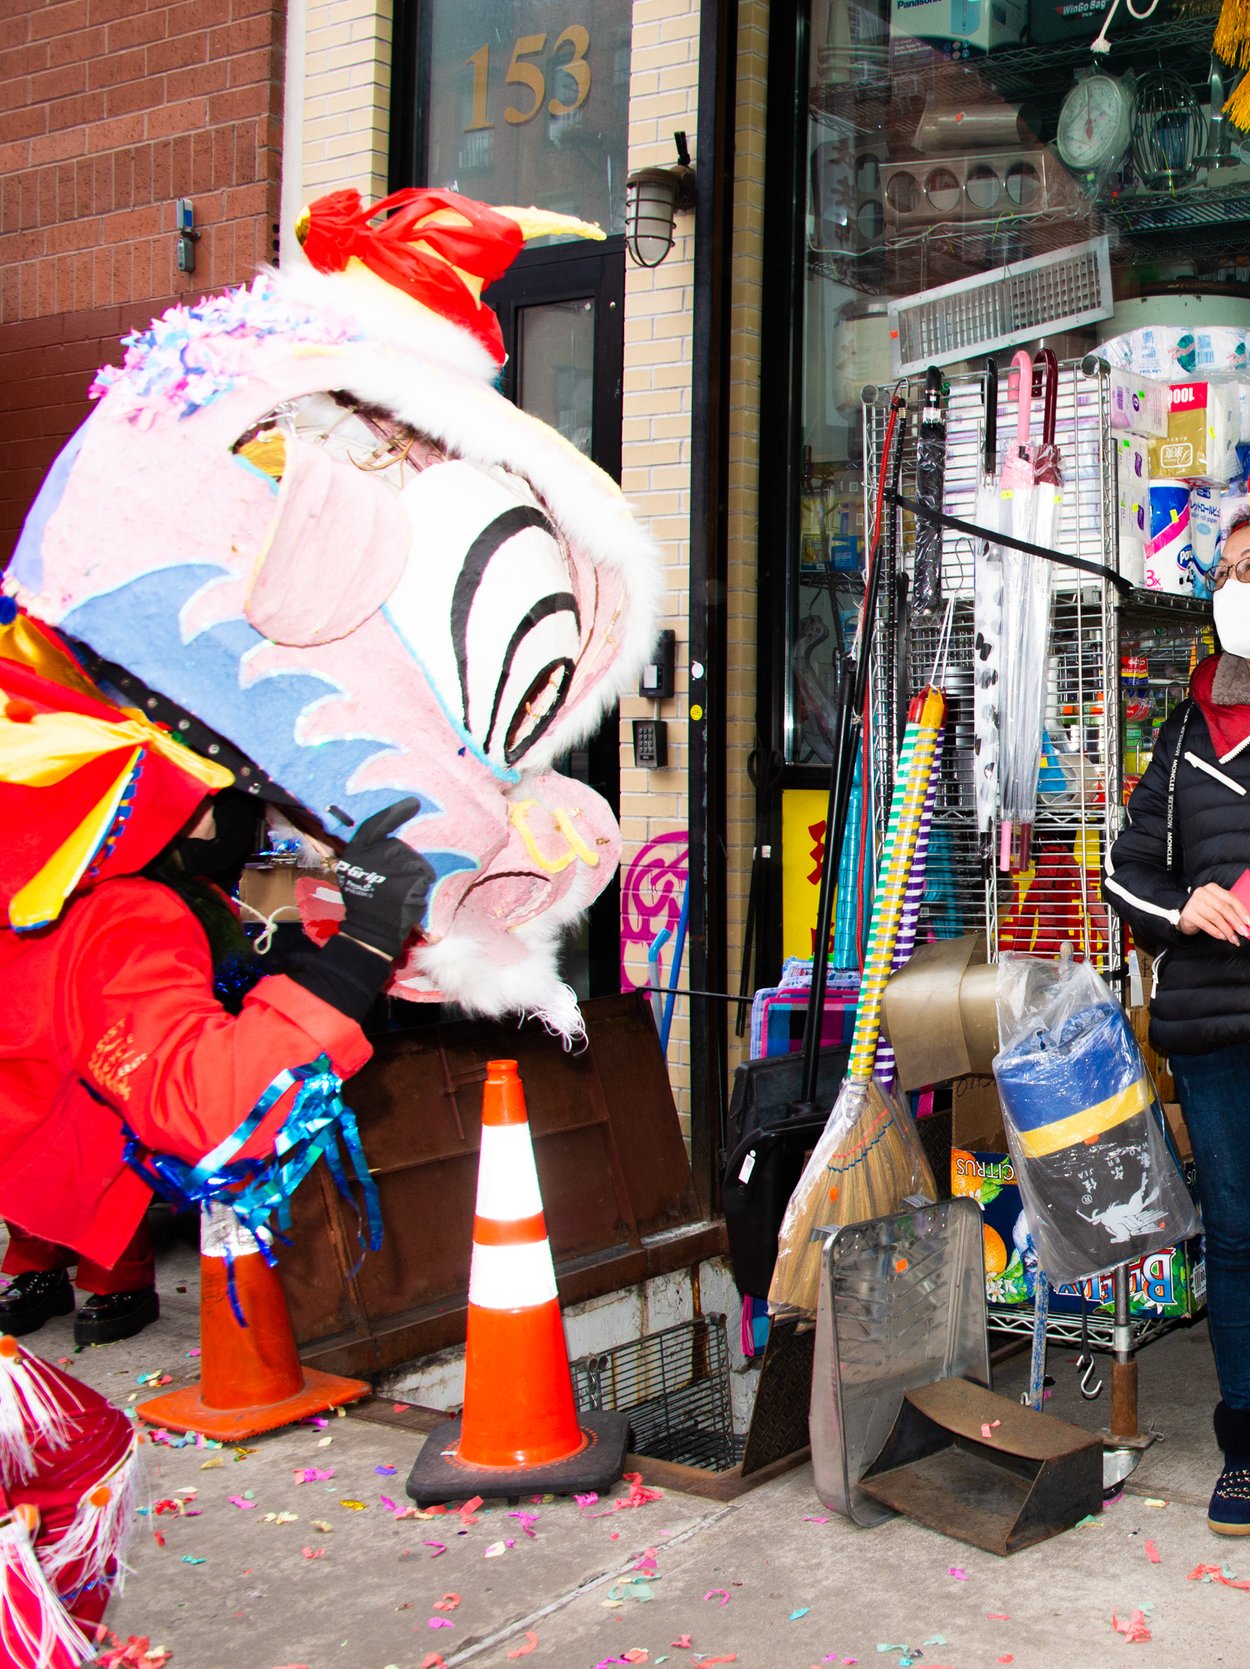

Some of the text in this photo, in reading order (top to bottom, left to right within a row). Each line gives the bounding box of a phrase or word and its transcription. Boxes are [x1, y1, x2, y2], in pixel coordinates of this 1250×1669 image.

[1062, 1, 1089, 15] WinGo
[1089, 0, 1107, 12] Bag
[464, 24, 591, 133] 153
[1168, 759, 1178, 792] MONCLER
[1166, 794, 1174, 829] MONCLER
[956, 1158, 1014, 1182] CITRUS
